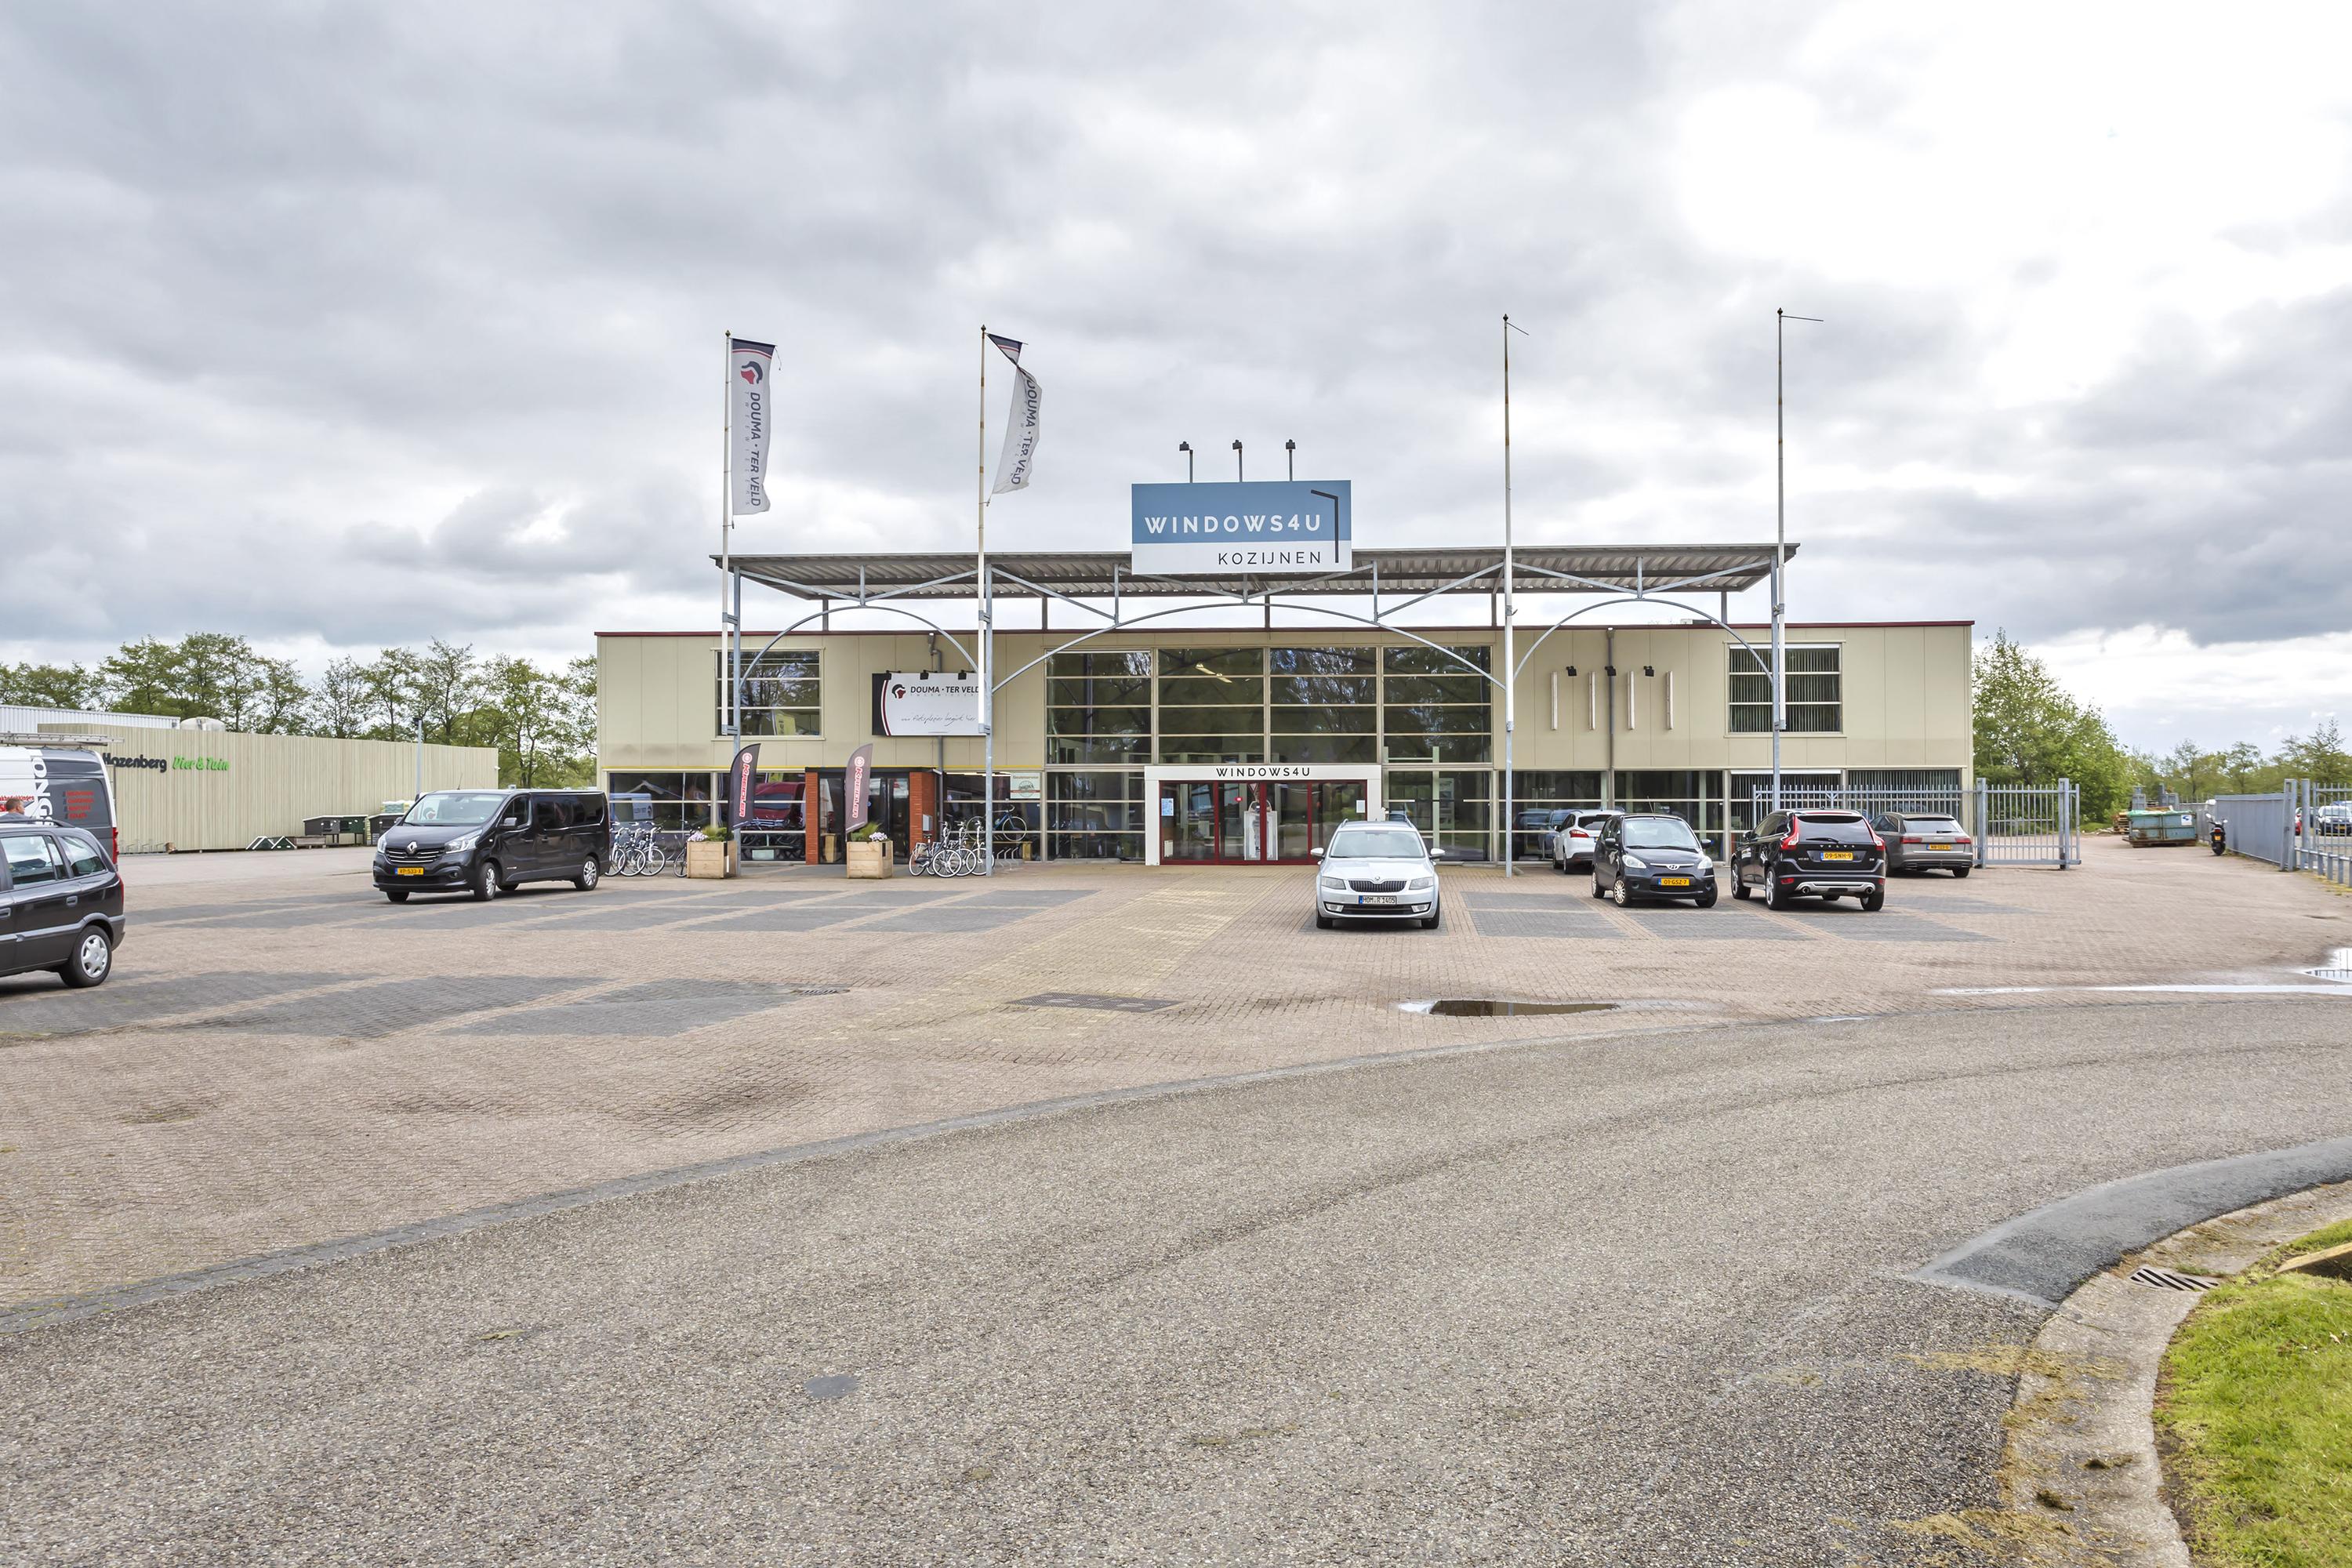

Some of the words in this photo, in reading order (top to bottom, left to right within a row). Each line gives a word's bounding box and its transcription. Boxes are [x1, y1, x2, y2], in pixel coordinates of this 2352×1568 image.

[750, 391, 761, 440] DOUMA
[750, 450, 760, 474] TER
[750, 476, 761, 507] VELD
[1144, 514, 1321, 535] WINDOWS4U
[1218, 551, 1321, 565] KOZIJNEN
[102, 753, 167, 773] Hazenberg
[172, 754, 194, 770] Dier
[196, 756, 205, 770] &
[206, 757, 230, 771] Tuin
[1215, 767, 1311, 777] WINDOWS4U
